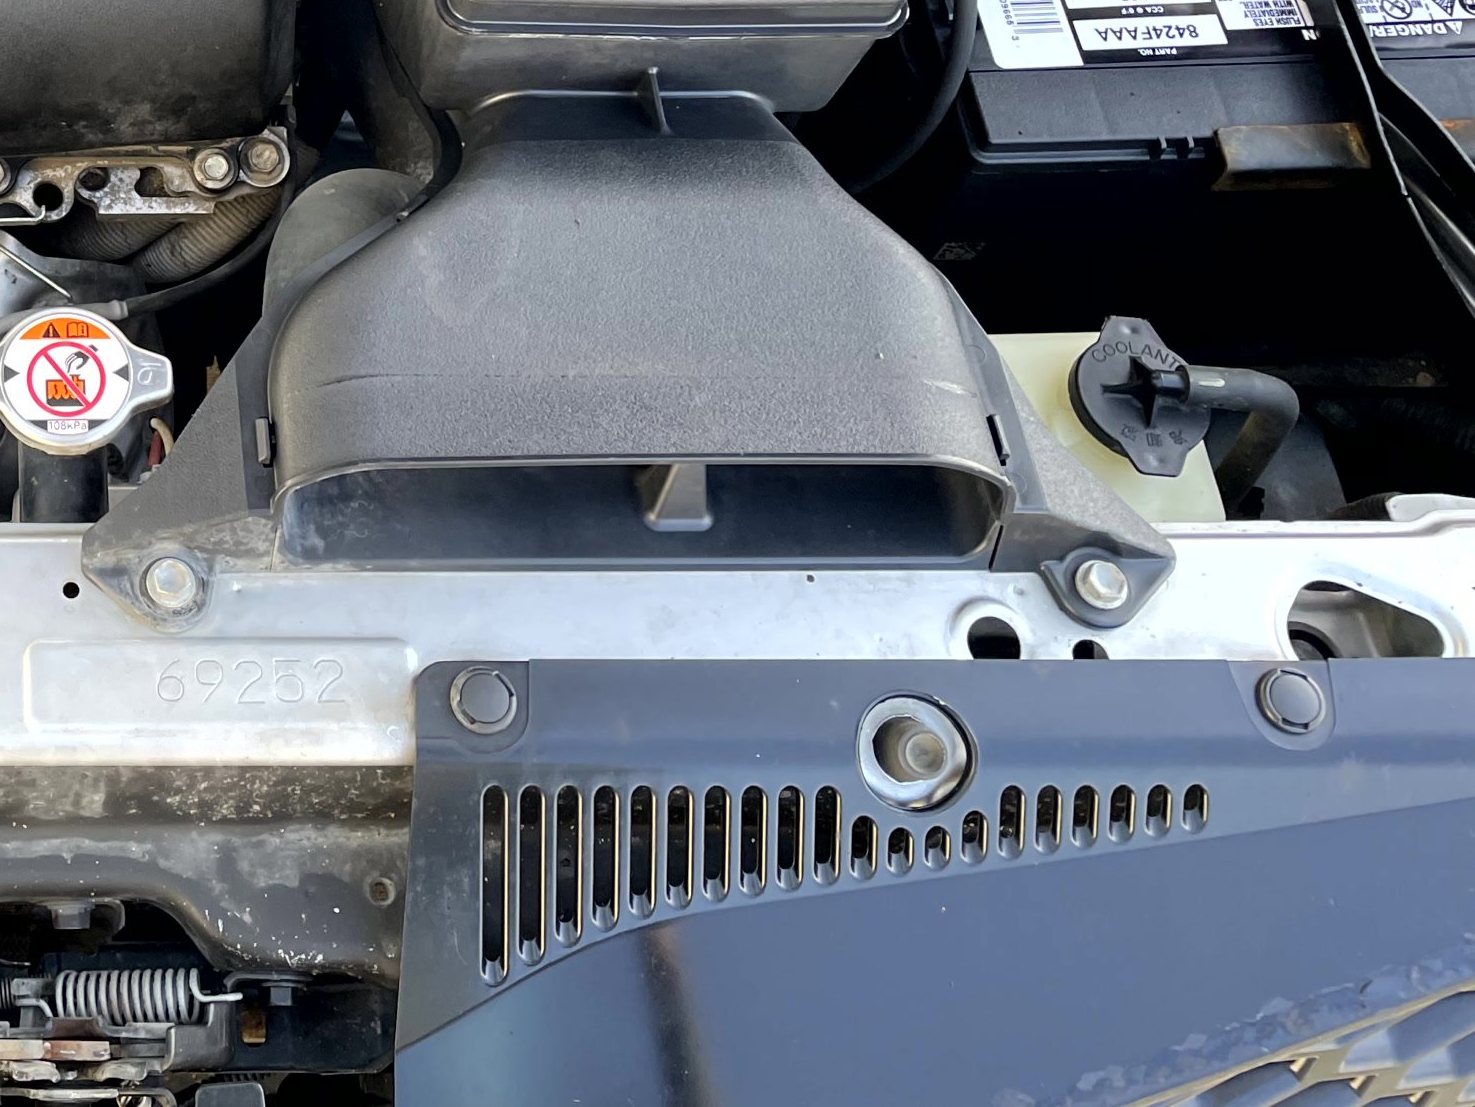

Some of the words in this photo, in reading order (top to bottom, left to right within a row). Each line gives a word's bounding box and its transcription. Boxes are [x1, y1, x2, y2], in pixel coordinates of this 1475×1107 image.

[1272, 0, 1294, 9] WITH
[1244, 8, 1298, 18] IMMEDIATELY
[1253, 18, 1274, 26] EYES
[1275, 16, 1301, 25] FLUSH
[1094, 24, 1199, 42] 8424FAAA
[1154, 47, 1177, 55] PART
[1091, 341, 1182, 369] COOLANT
[49, 420, 87, 431] 108kPa
[155, 658, 346, 704] 69252
